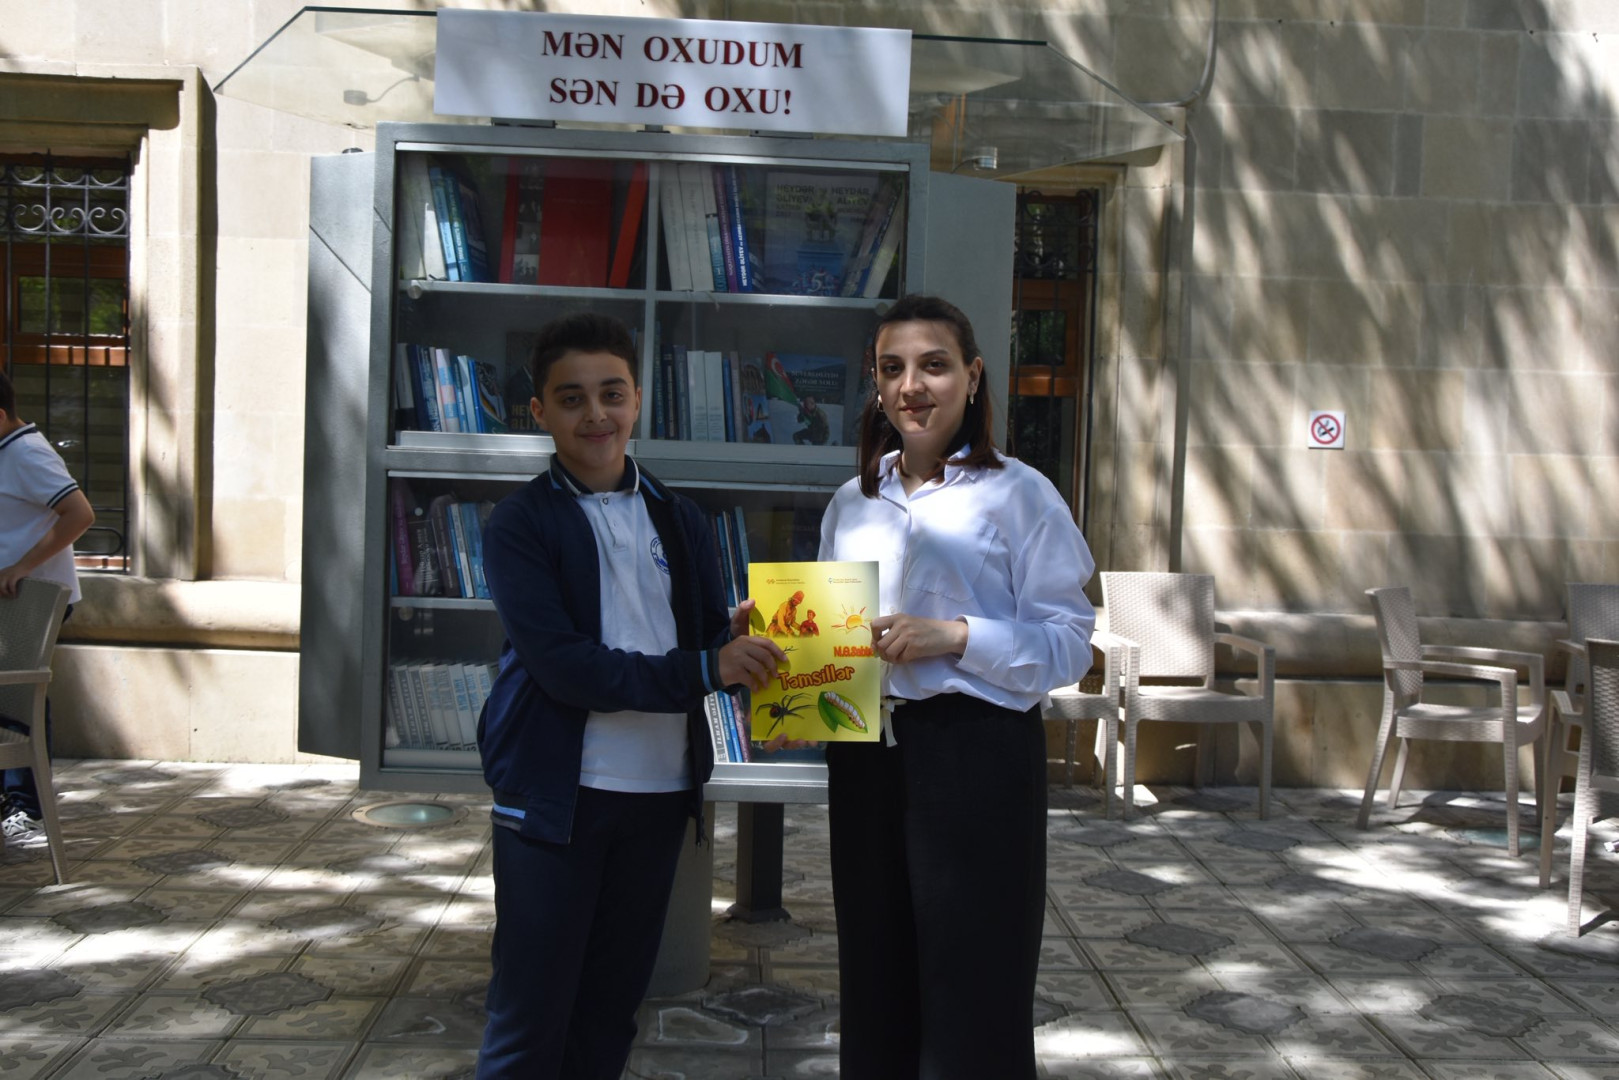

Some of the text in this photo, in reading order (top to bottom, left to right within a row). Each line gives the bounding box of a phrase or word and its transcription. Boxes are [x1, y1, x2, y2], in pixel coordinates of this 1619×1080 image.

[541, 30, 804, 69] MƏN OXUDUM
[549, 77, 792, 116] SƏN DƏ OXU!
[778, 663, 855, 691] Təmsillər
